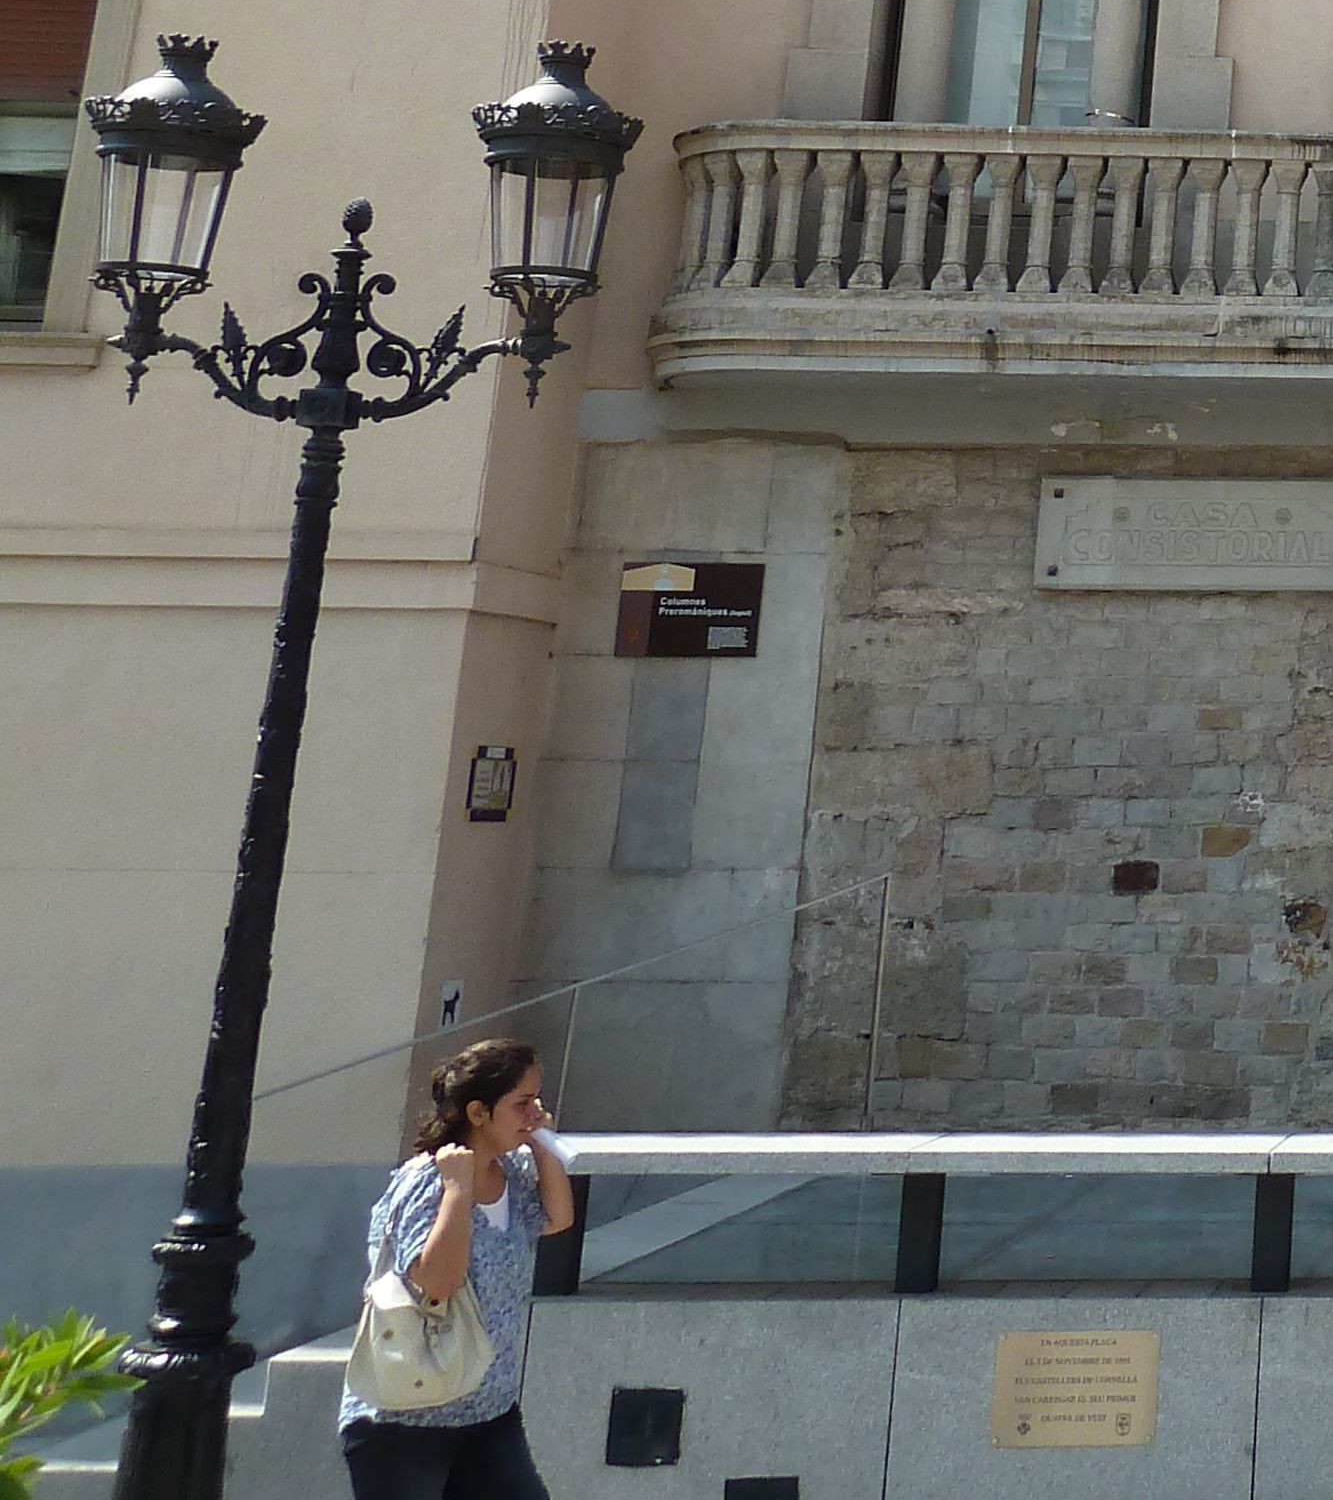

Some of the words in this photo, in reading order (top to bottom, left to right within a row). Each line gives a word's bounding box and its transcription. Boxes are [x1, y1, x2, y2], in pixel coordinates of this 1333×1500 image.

[1146, 502, 1259, 529] CASA
[1069, 529, 1333, 563] CONSISTORIAL
[660, 597, 706, 605] Columnes
